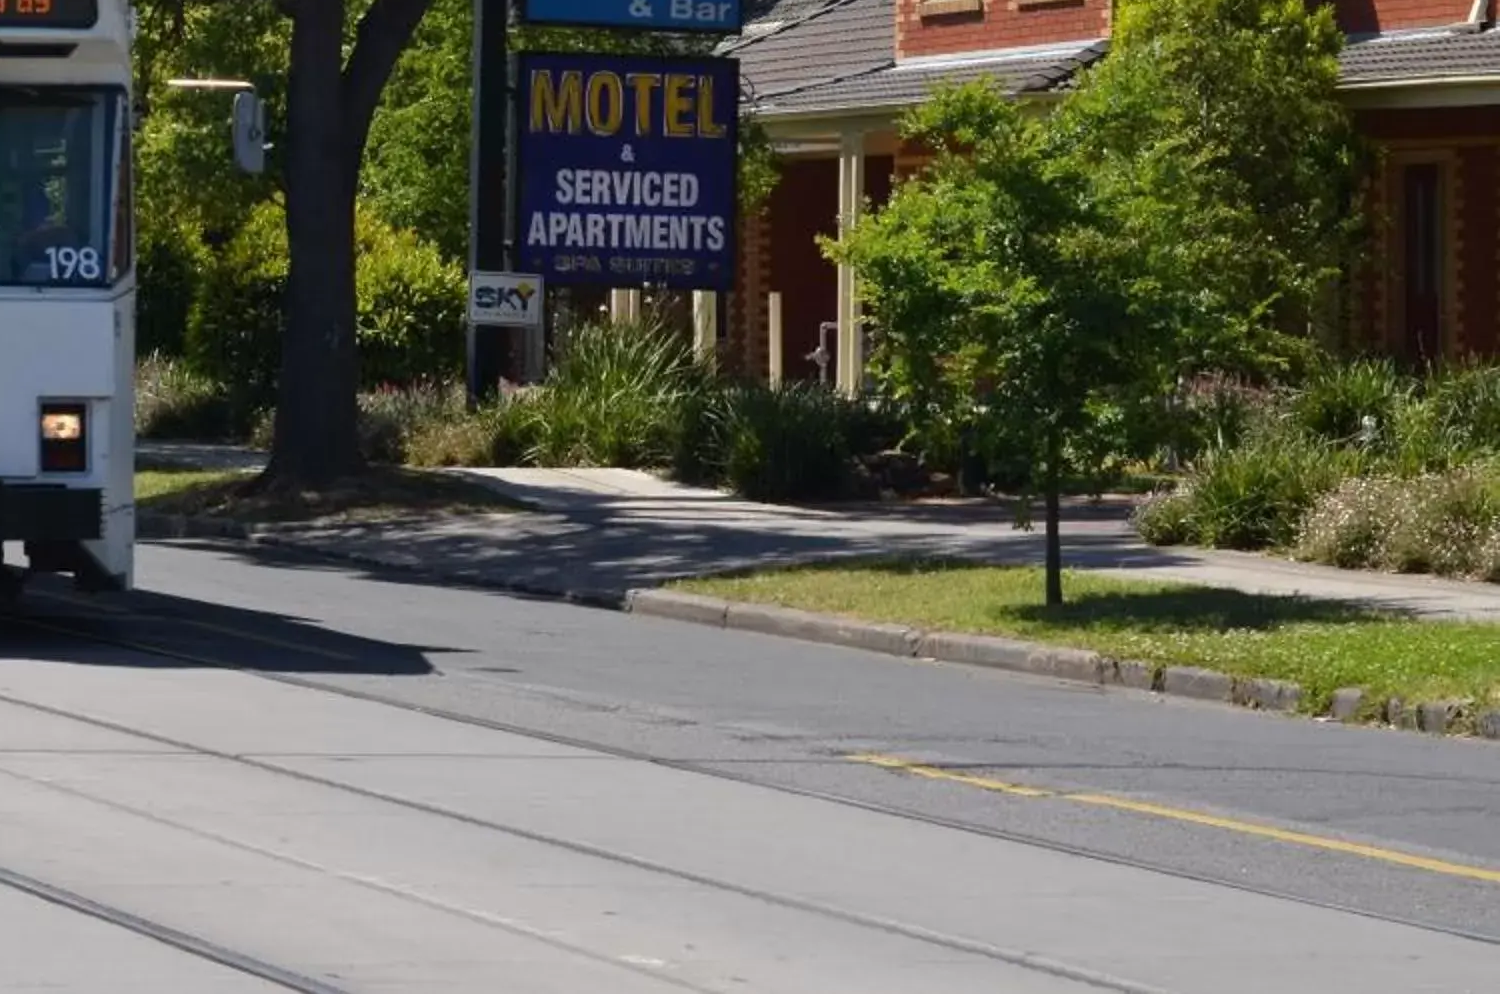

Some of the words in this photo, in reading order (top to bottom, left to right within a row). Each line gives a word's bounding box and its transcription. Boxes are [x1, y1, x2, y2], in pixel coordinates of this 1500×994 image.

[529, 68, 728, 139] MOTEL
[620, 143, 635, 163] &
[555, 168, 700, 207] SERVICED
[527, 210, 725, 251] APARTMENTS
[44, 247, 100, 280] 198
[475, 284, 536, 312] SKY
